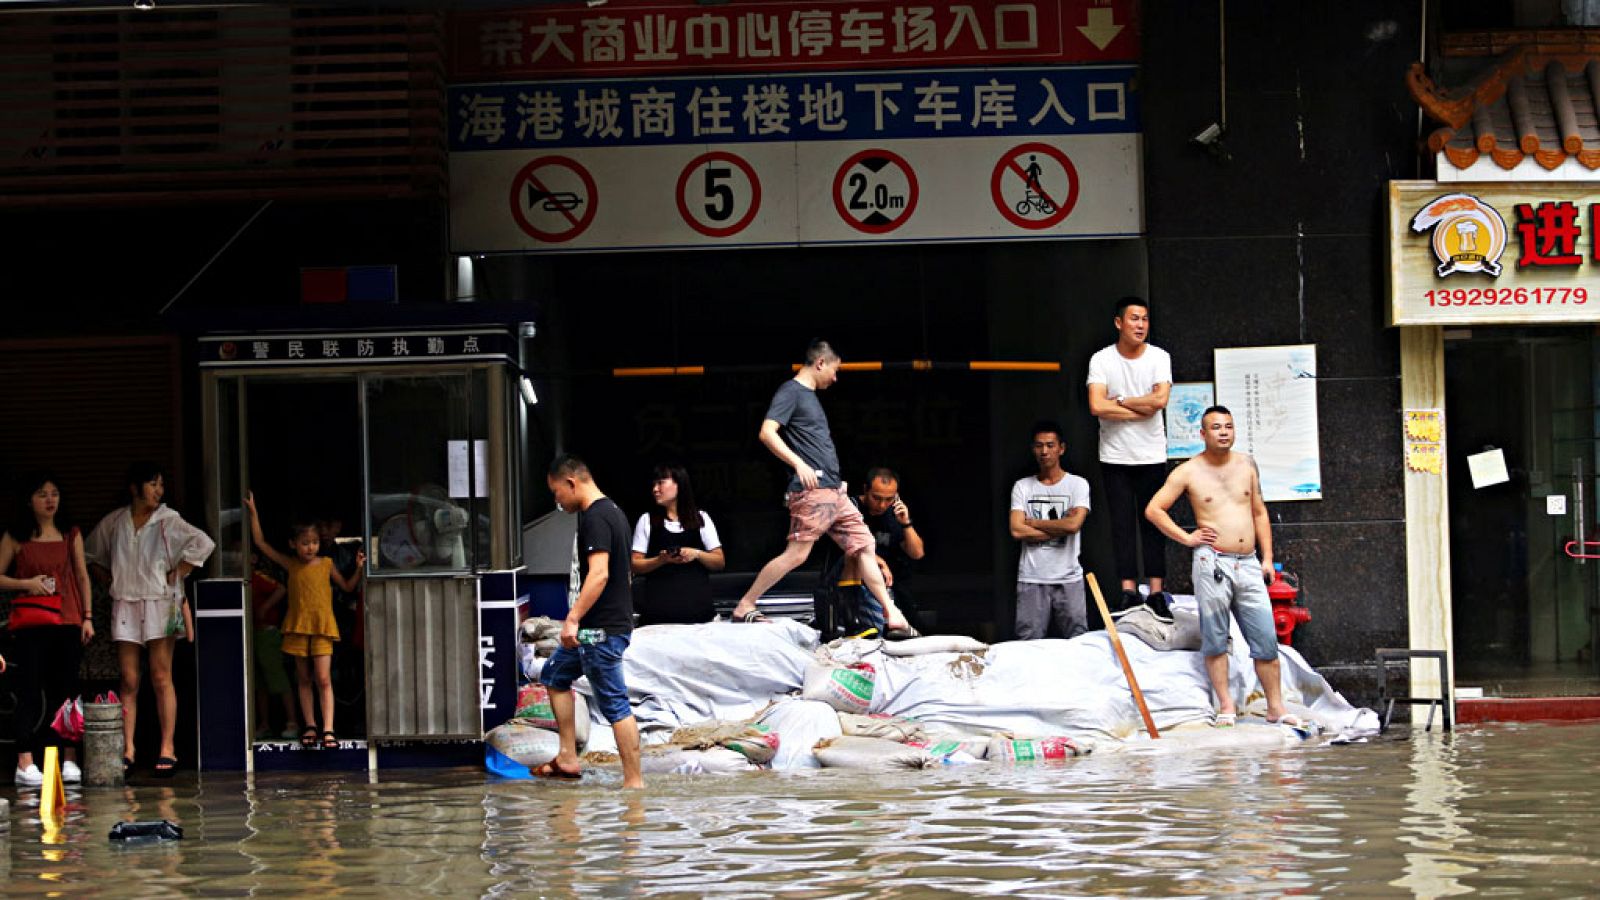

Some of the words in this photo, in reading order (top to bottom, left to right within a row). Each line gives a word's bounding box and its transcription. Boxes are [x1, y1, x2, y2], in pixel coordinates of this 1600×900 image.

[479, 3, 1039, 65] 荣大商业中心停车场入口
[457, 77, 1126, 144] 海港城商住楼地下车库入口
[705, 168, 734, 221] 5
[849, 172, 904, 210] 2.0m
[1518, 201, 1600, 268] 进
[1424, 287, 1588, 307] 13929261779
[252, 335, 481, 360] 警民联防执勤点
